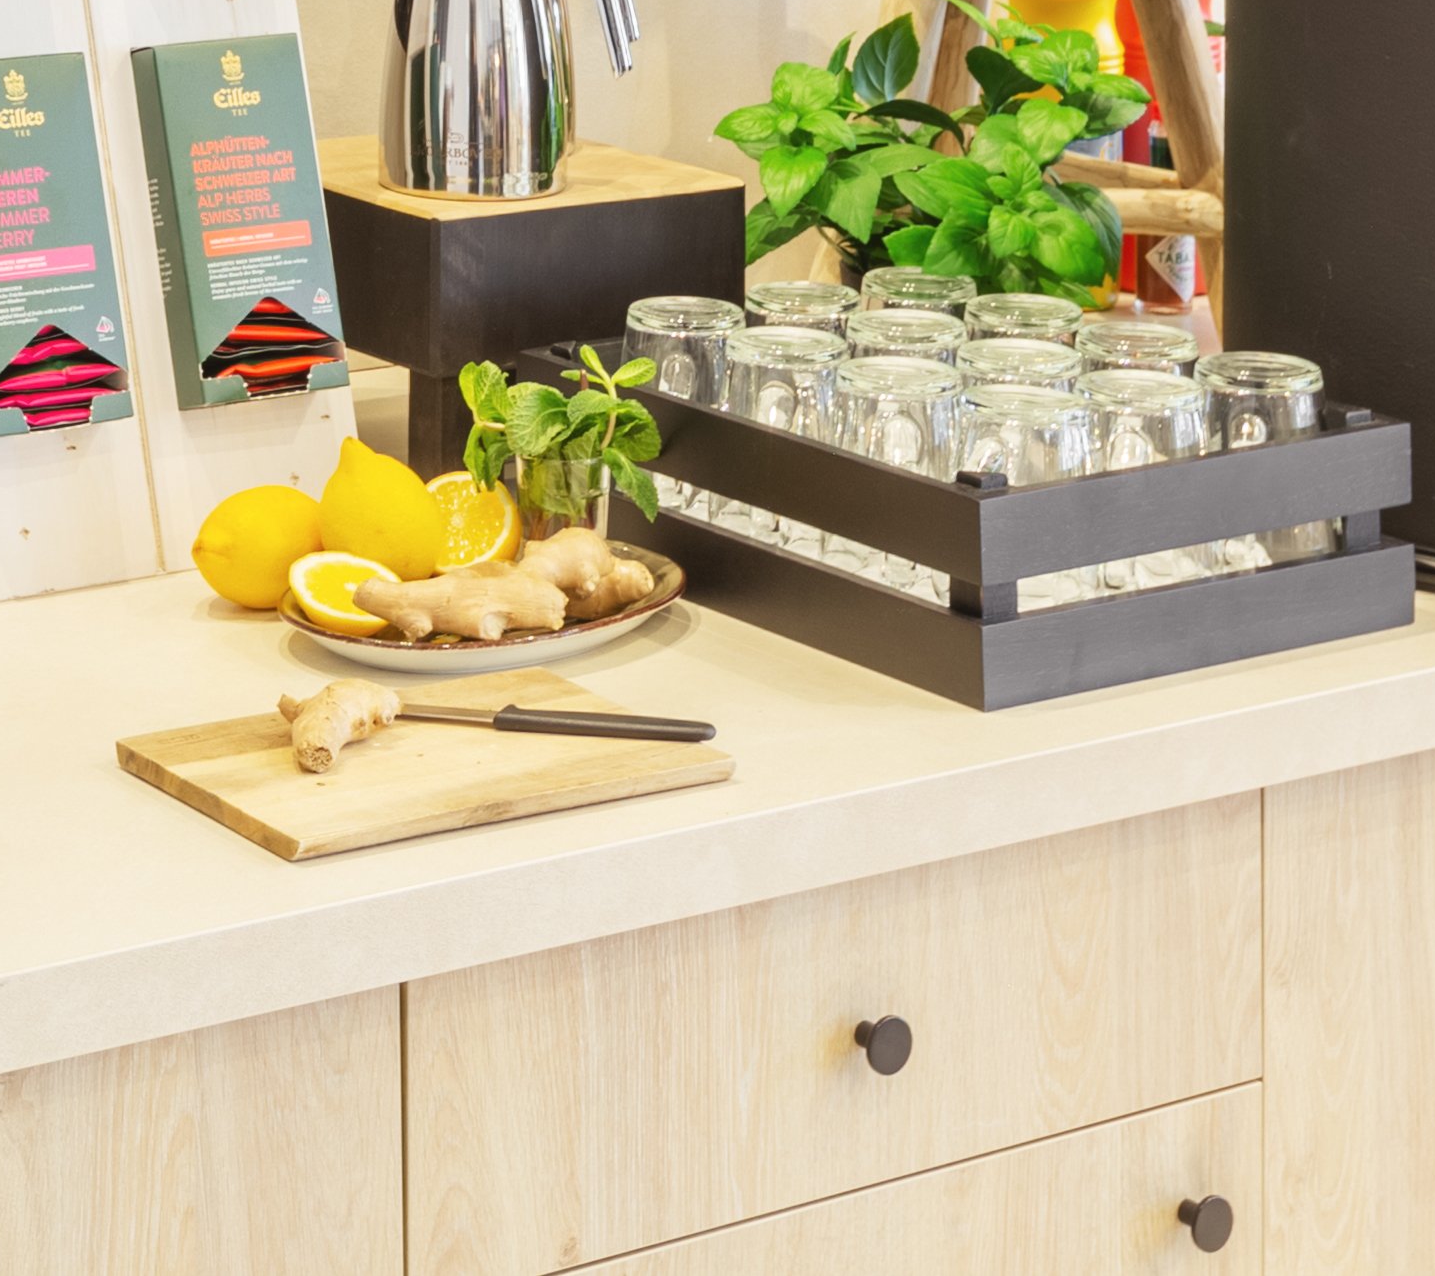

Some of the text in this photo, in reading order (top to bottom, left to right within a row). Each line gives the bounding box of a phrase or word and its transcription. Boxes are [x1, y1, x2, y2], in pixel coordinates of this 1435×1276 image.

[213, 87, 261, 109] Eilles
[231, 108, 248, 117] TEE
[14, 129, 31, 138] TEE
[190, 135, 270, 157] ALPHÜTTEN-
[192, 150, 293, 173] KRÄUTER NACH
[194, 167, 296, 191] SCHWEIZER ART
[198, 187, 271, 209] ALP HERBS
[200, 203, 281, 226] SWISS STYLE
